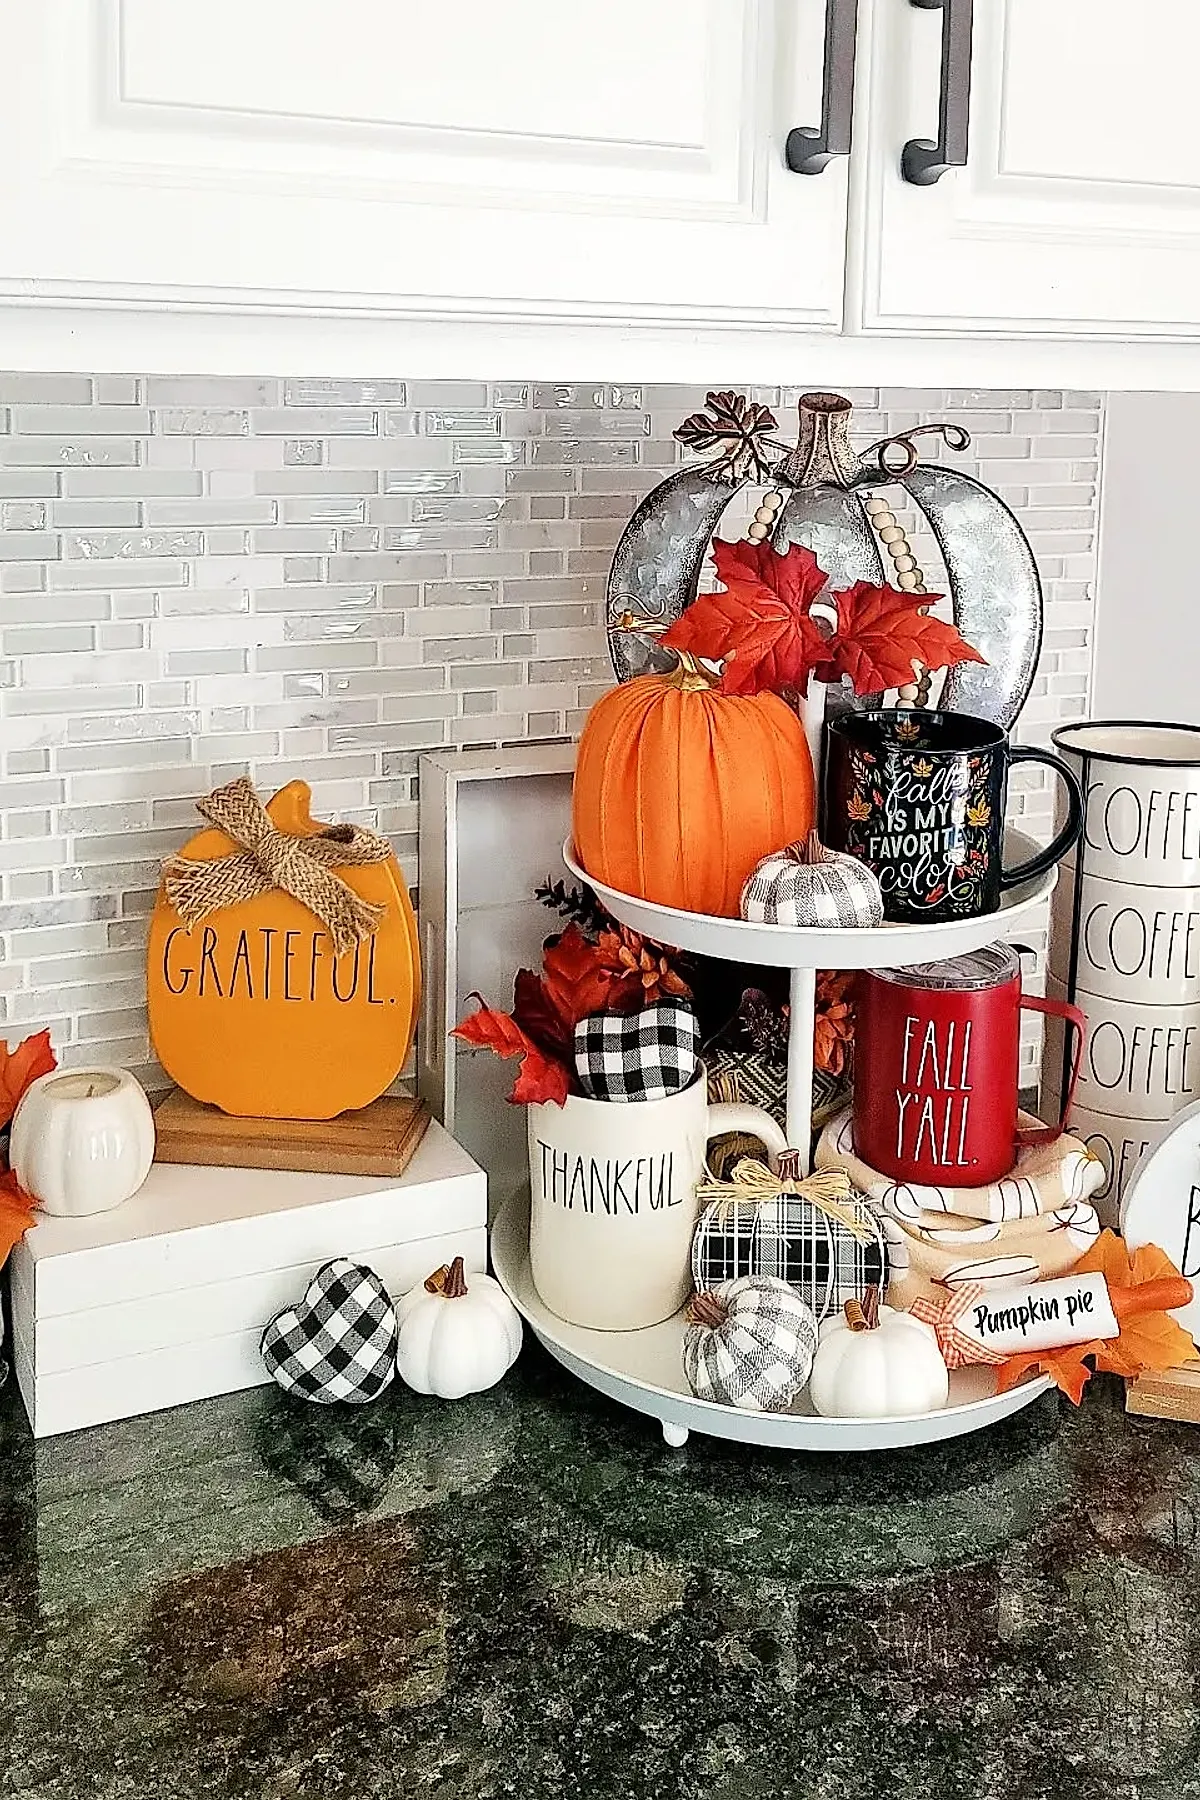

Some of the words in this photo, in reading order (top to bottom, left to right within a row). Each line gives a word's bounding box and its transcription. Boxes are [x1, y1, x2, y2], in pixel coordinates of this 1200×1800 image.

[885, 763, 960, 817] fall
[887, 808, 908, 833] IS
[915, 802, 950, 831] MY
[1085, 782, 1200, 860] COFFE
[869, 828, 964, 859] FAVORITE
[879, 850, 975, 910] color
[163, 926, 396, 1004] GRATEFUL.
[902, 1016, 973, 1091] FALL
[896, 1088, 979, 1166] Y'ALL.
[537, 1139, 683, 1216] THANKFUL
[972, 1295, 1060, 1338] Pumpkin
[1064, 1288, 1095, 1327] pie
